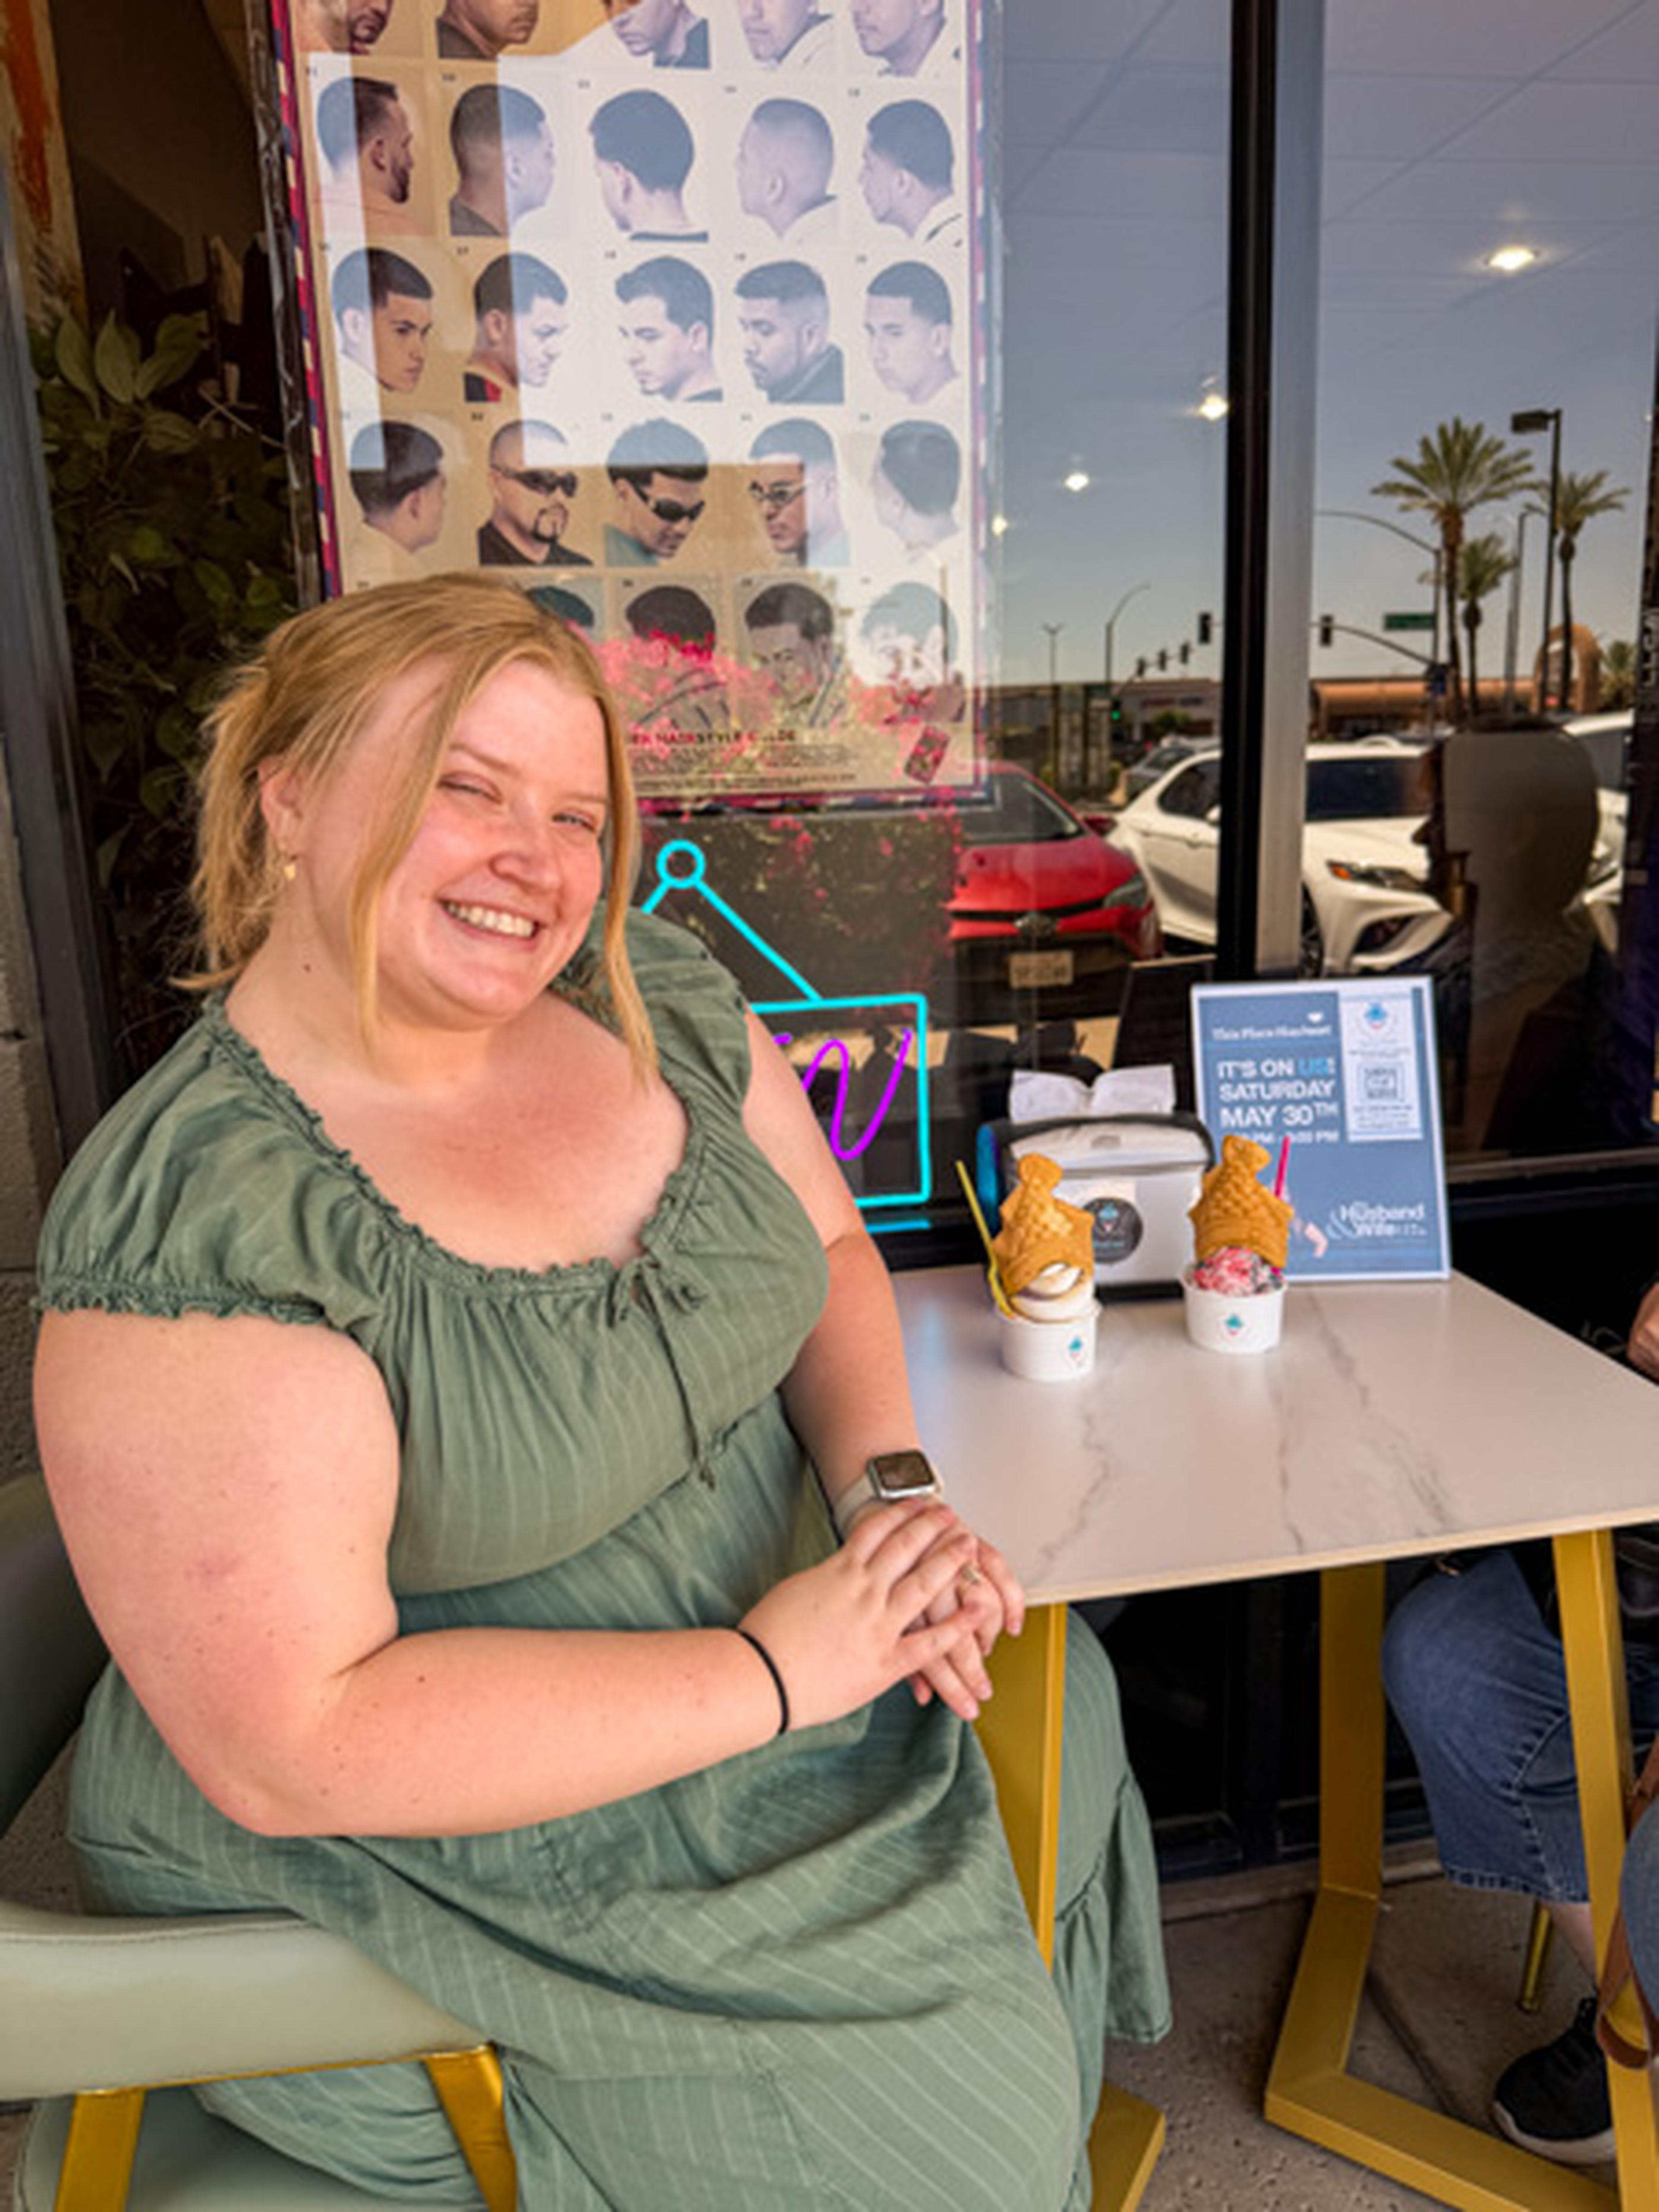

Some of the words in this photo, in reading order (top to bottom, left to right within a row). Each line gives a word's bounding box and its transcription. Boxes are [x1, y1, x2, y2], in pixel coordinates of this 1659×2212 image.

[1218, 1059, 1256, 1078] IT'S
[1260, 1058, 1294, 1077] ON
[1219, 1079, 1335, 1102] SATURDAY
[1220, 1104, 1277, 1128] MAY
[1316, 1128, 1339, 1143] PM
[1340, 1202, 1425, 1222] Husband
